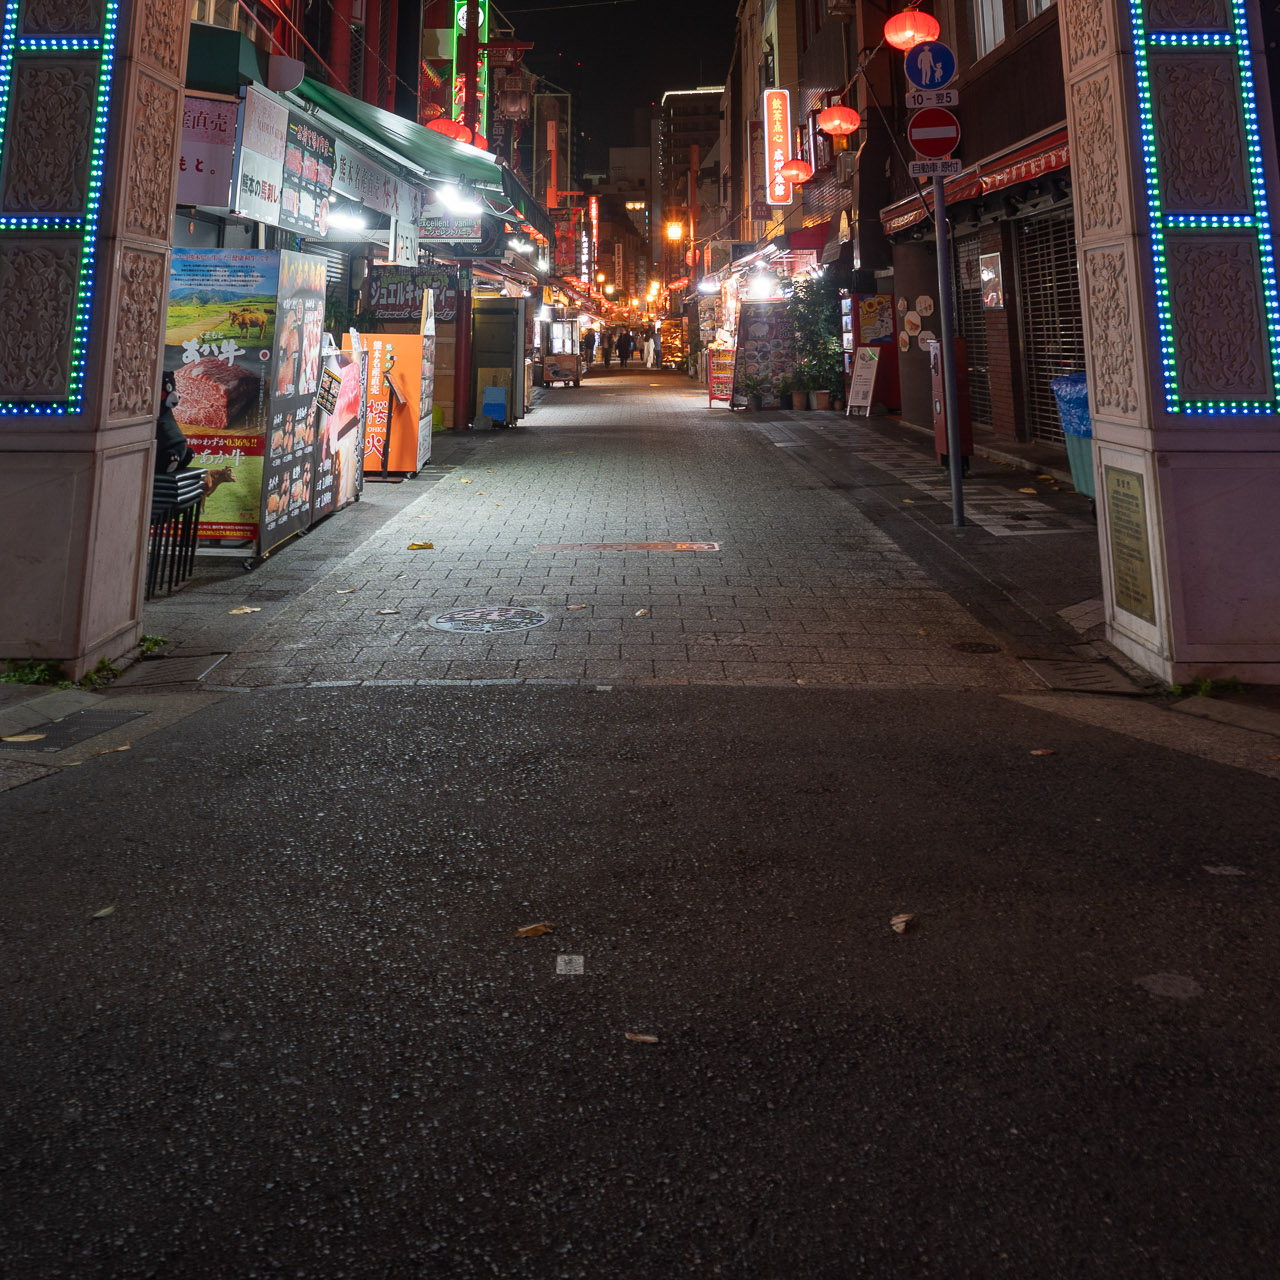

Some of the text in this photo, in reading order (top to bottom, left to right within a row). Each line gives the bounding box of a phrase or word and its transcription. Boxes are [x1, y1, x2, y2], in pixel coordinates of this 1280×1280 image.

[771, 97, 784, 143] 飲茶点心
[241, 172, 280, 205] 熊本の馬刺し
[414, 308, 457, 321] Cdy
[181, 336, 247, 368] あか牛
[370, 340, 382, 395] 熊本名産直売
[364, 399, 392, 460] 桜火
[199, 448, 246, 467] あか牛
